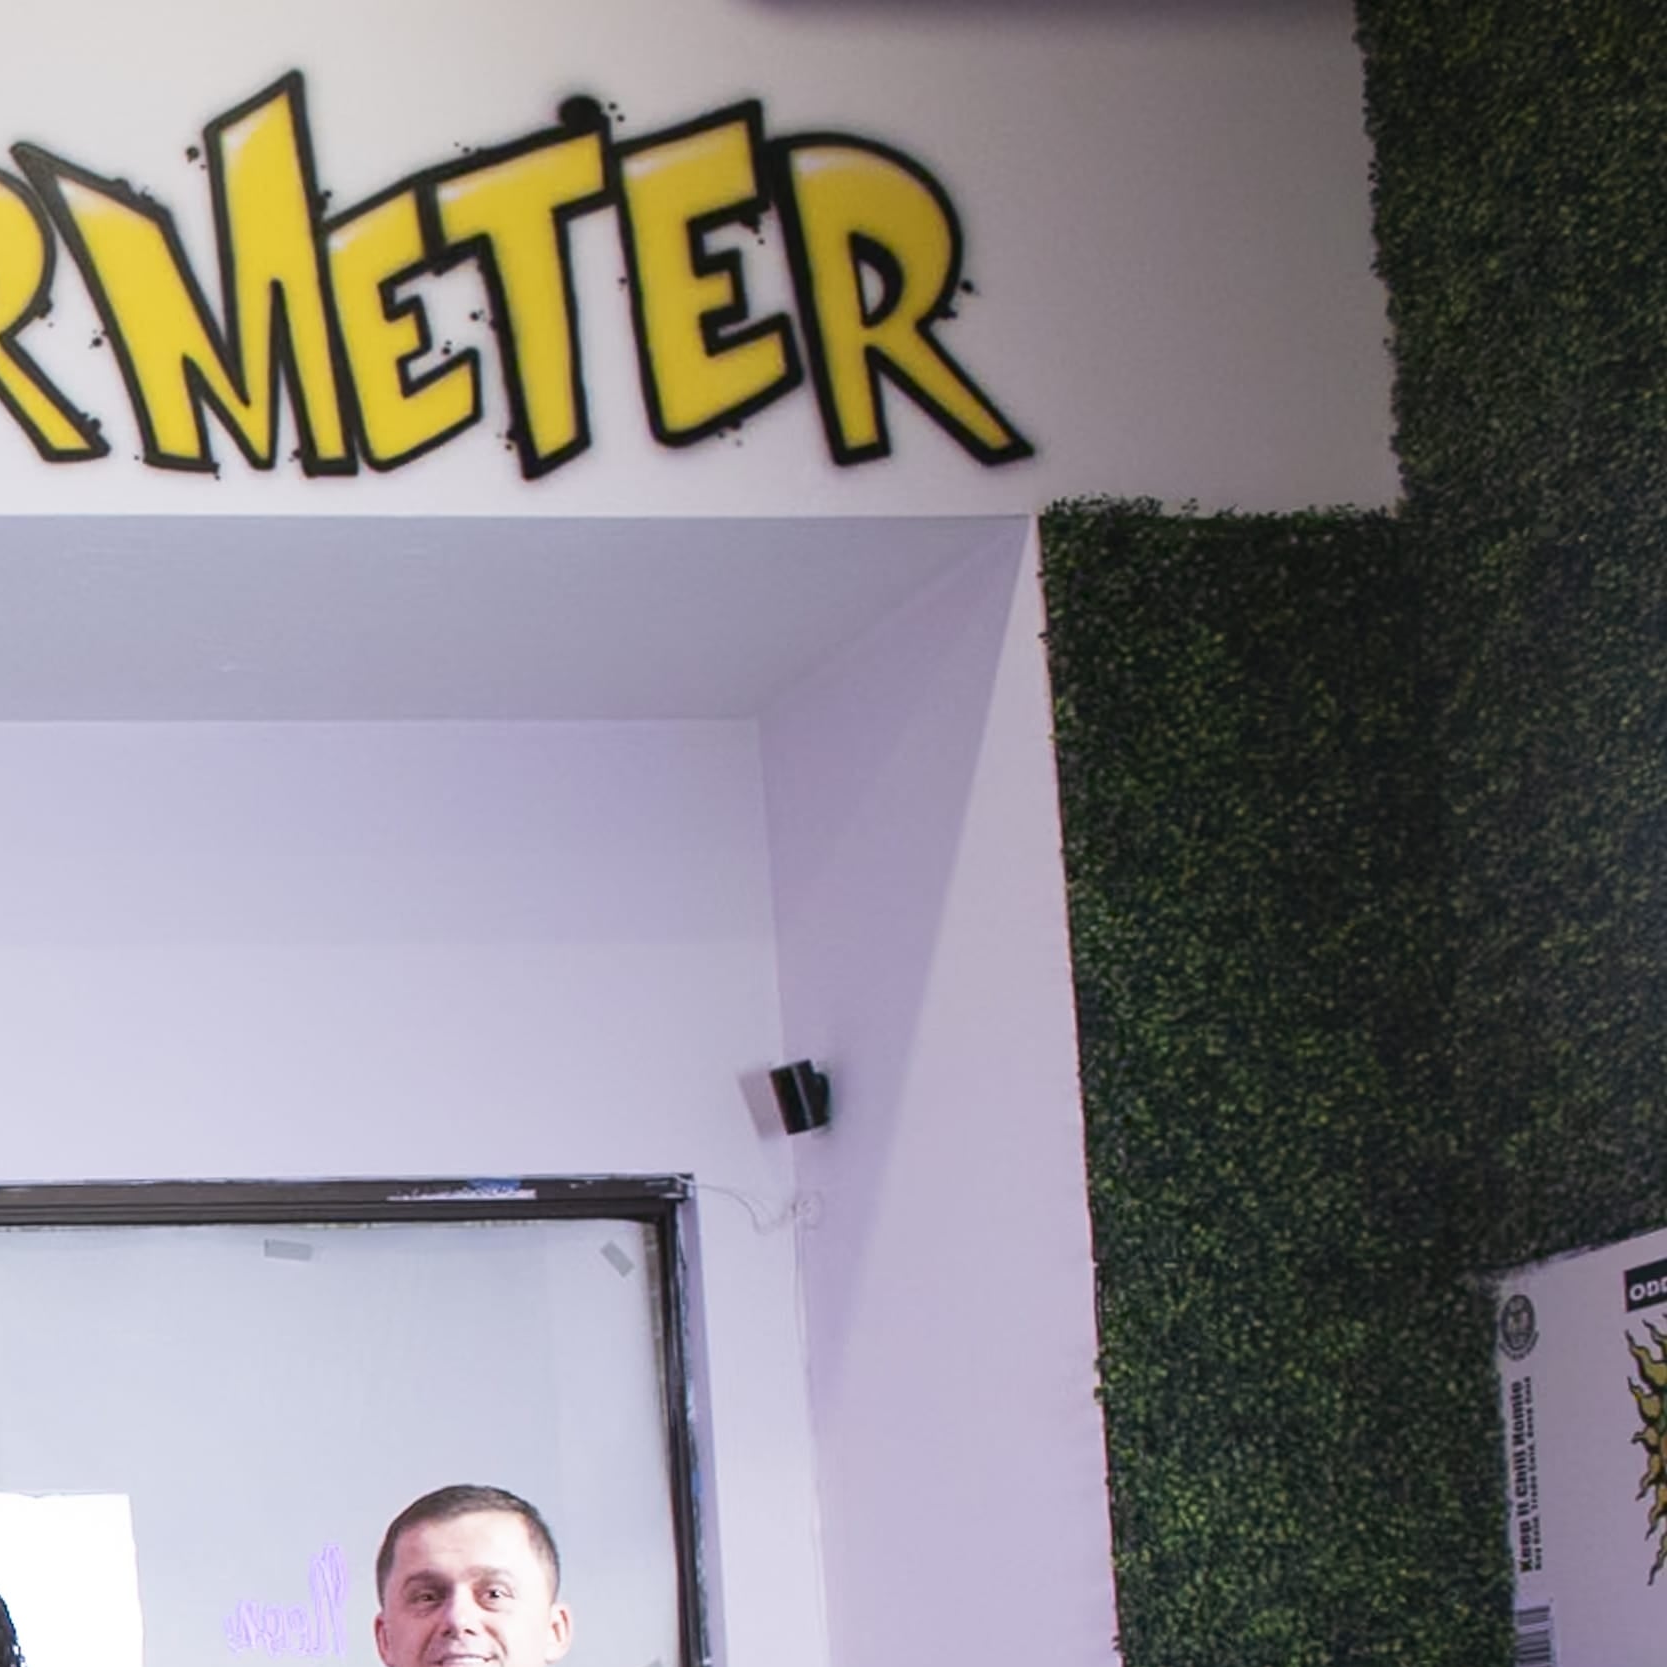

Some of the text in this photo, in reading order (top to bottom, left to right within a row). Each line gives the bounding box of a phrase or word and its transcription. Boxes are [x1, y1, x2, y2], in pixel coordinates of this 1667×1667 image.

[9, 69, 1035, 479] METER
[1512, 1448, 1529, 1498] Chill
[1519, 1520, 1533, 1573] Keep
